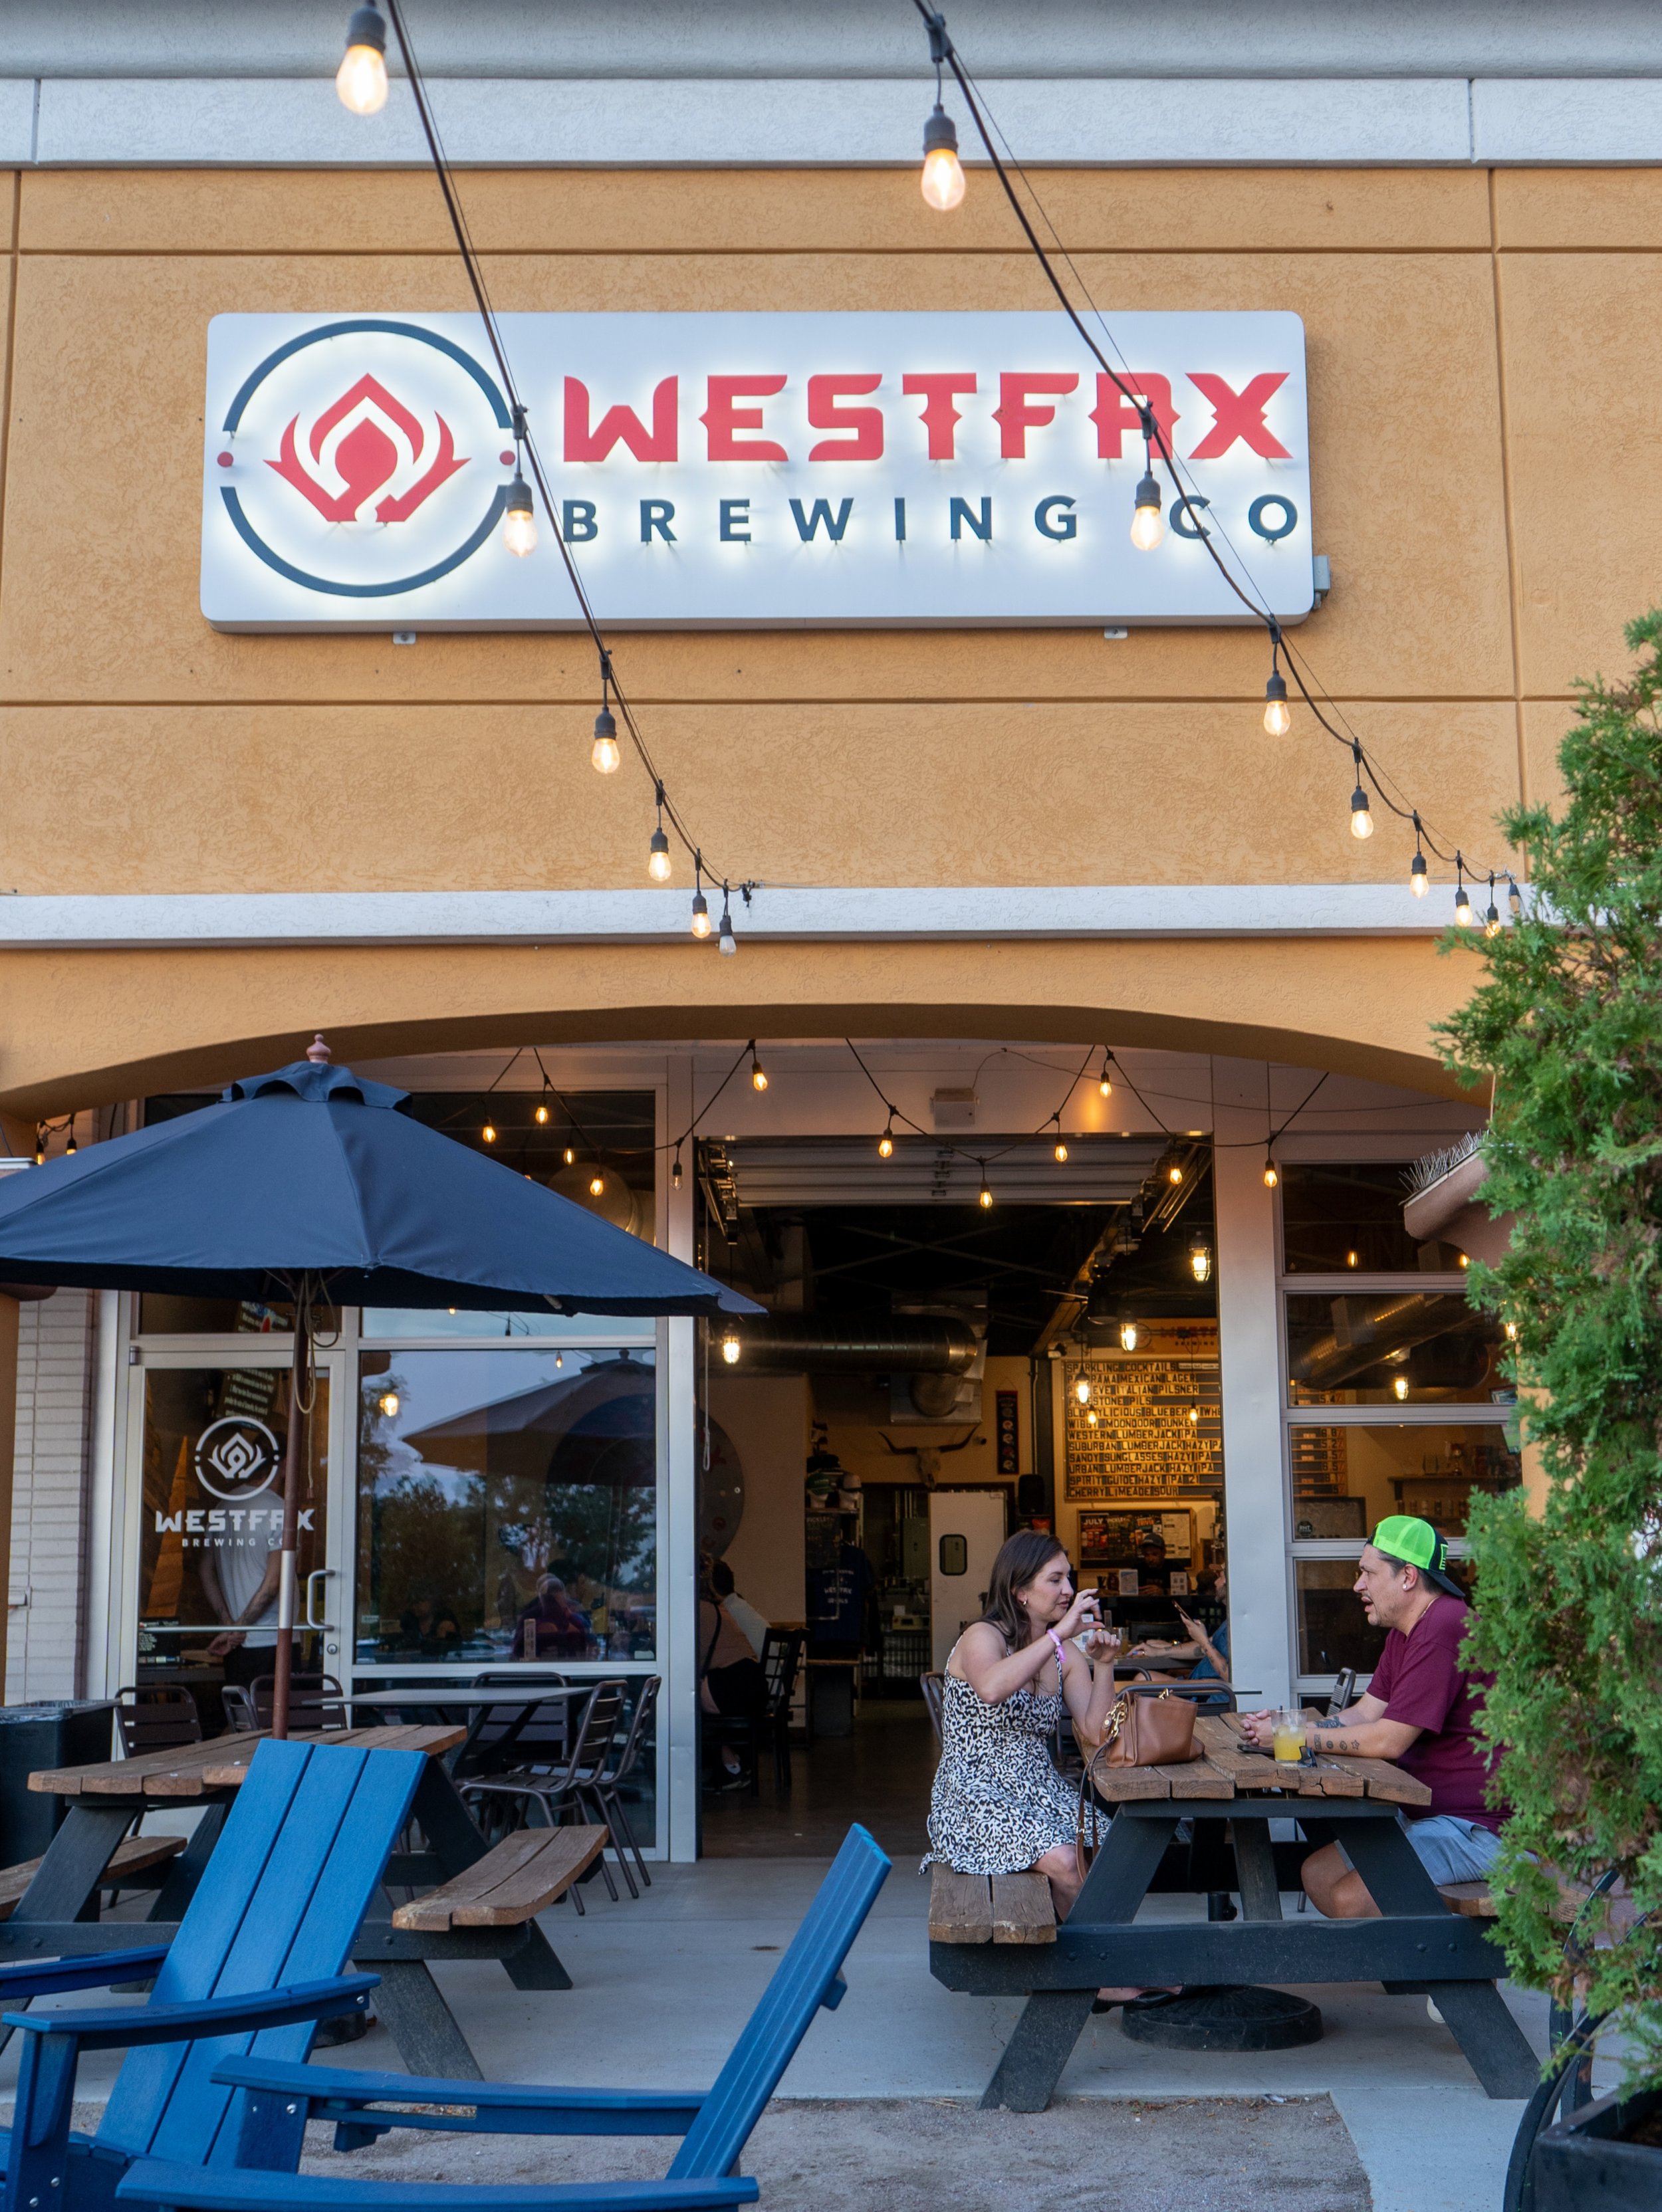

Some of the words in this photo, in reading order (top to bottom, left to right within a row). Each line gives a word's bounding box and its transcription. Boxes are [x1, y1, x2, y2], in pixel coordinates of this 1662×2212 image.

[564, 372, 1293, 462] WESTFAX
[562, 495, 1077, 542] BREWING
[1169, 494, 1298, 540] CO
[1126, 1363, 1175, 1372] COCKTAILS
[1121, 1374, 1160, 1383] MEXICAN
[1166, 1373, 1195, 1382] LAGER
[1117, 1384, 1153, 1394] ITALIAN
[1159, 1384, 1197, 1394] PILSNER
[1130, 1396, 1151, 1405] PILS
[1069, 1430, 1112, 1439] WESTERN
[1117, 1430, 1177, 1439] LUMBERJACK
[1181, 1429, 1197, 1438] IPA
[1069, 1441, 1116, 1451] SUBURBAN
[1122, 1440, 1182, 1450] LUMBERJACK
[1186, 1440, 1208, 1450] HAZY
[1069, 1453, 1098, 1462] SANDY
[1104, 1452, 1163, 1462] SUNGLASSES
[1168, 1452, 1191, 1461] HAZY
[1195, 1452, 1211, 1461] IPA
[1069, 1464, 1098, 1474] URBAN
[1105, 1464, 1165, 1473] LUMBERJACK
[1170, 1463, 1193, 1473] HAZY
[1198, 1463, 1213, 1472] IPA
[1070, 1476, 1102, 1485] SPIRIT
[1108, 1475, 1134, 1485] GUIDE
[1137, 1475, 1161, 1484] HAZY
[1167, 1475, 1183, 1484] IPA
[1070, 1487, 1104, 1497] CHERRY
[1109, 1486, 1150, 1496] LIMEADE
[1154, 1486, 1177, 1495] SOUR
[156, 1509, 314, 1532] WESTFAX
[182, 1538, 255, 1547] BREWING
